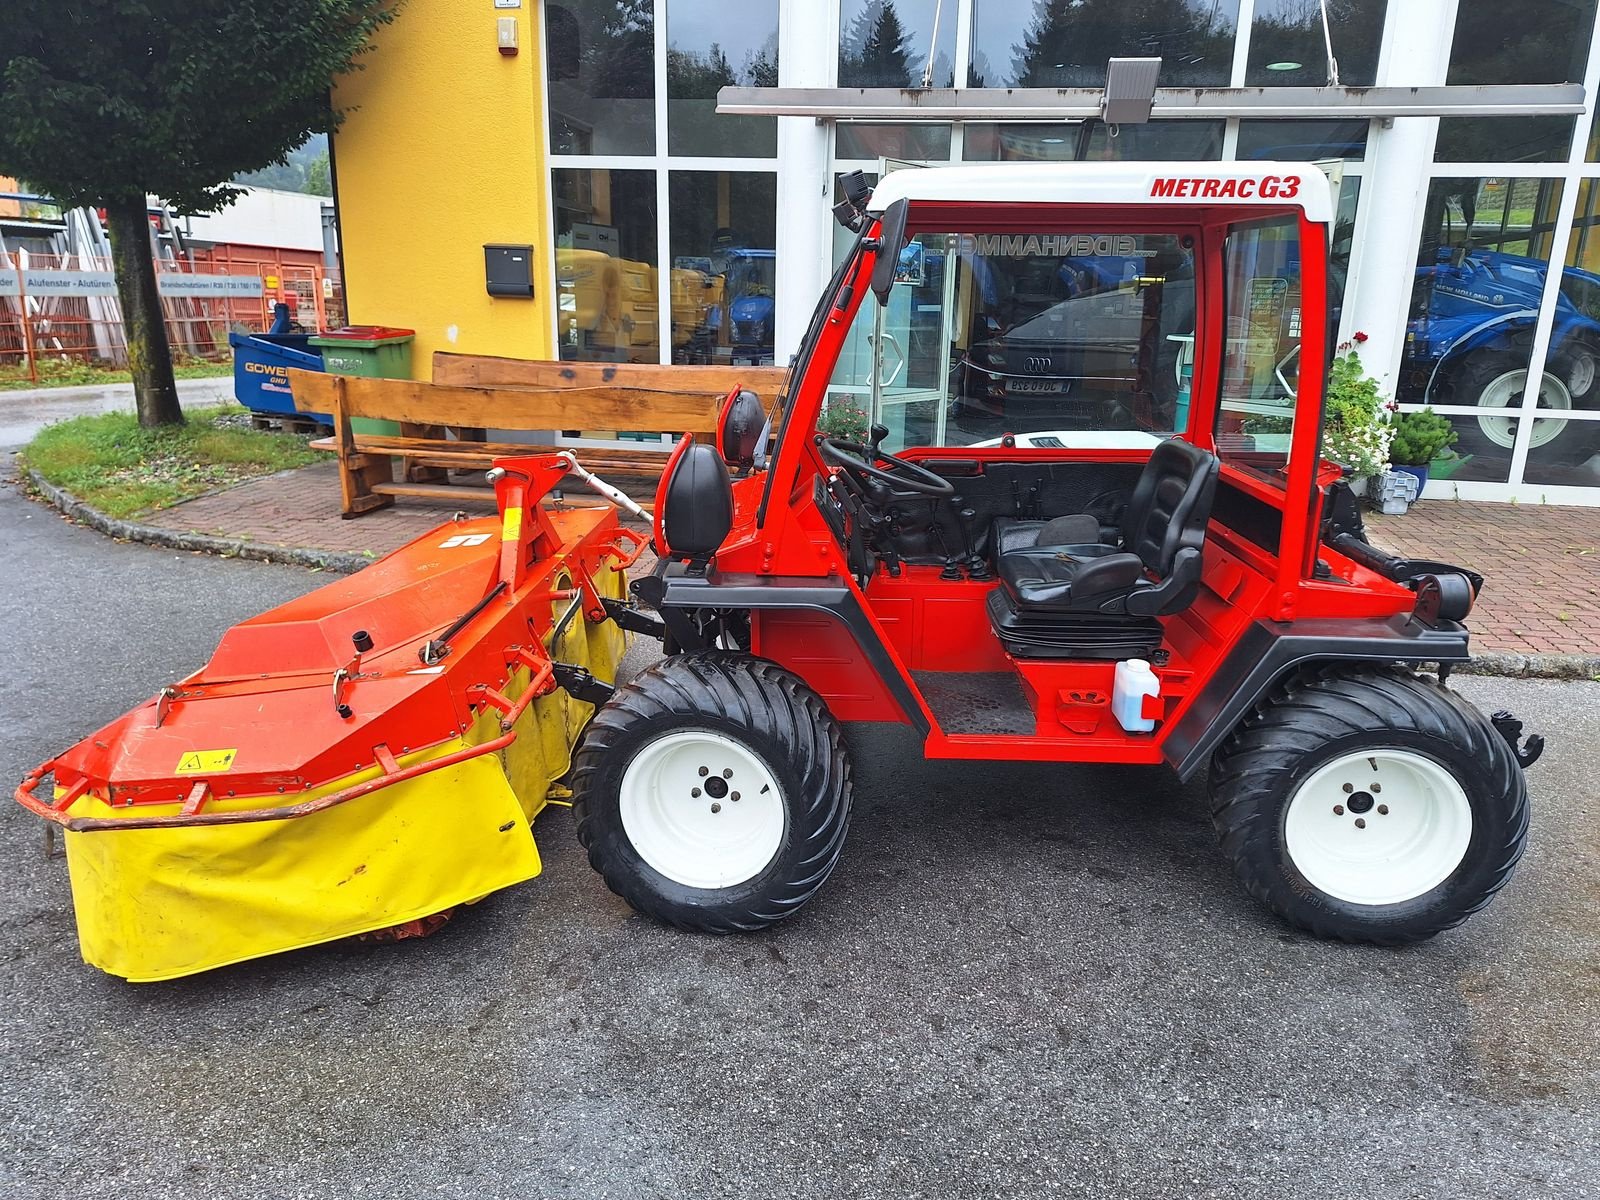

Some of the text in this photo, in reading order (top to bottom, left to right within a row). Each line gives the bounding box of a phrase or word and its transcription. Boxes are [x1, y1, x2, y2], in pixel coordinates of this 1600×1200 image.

[1150, 175, 1301, 199] METRAC G3
[28, 278, 70, 288] Alufenster
[78, 278, 111, 288] Alutüren
[1455, 287, 1490, 302] HOLLAND
[270, 376, 287, 385] GHU
